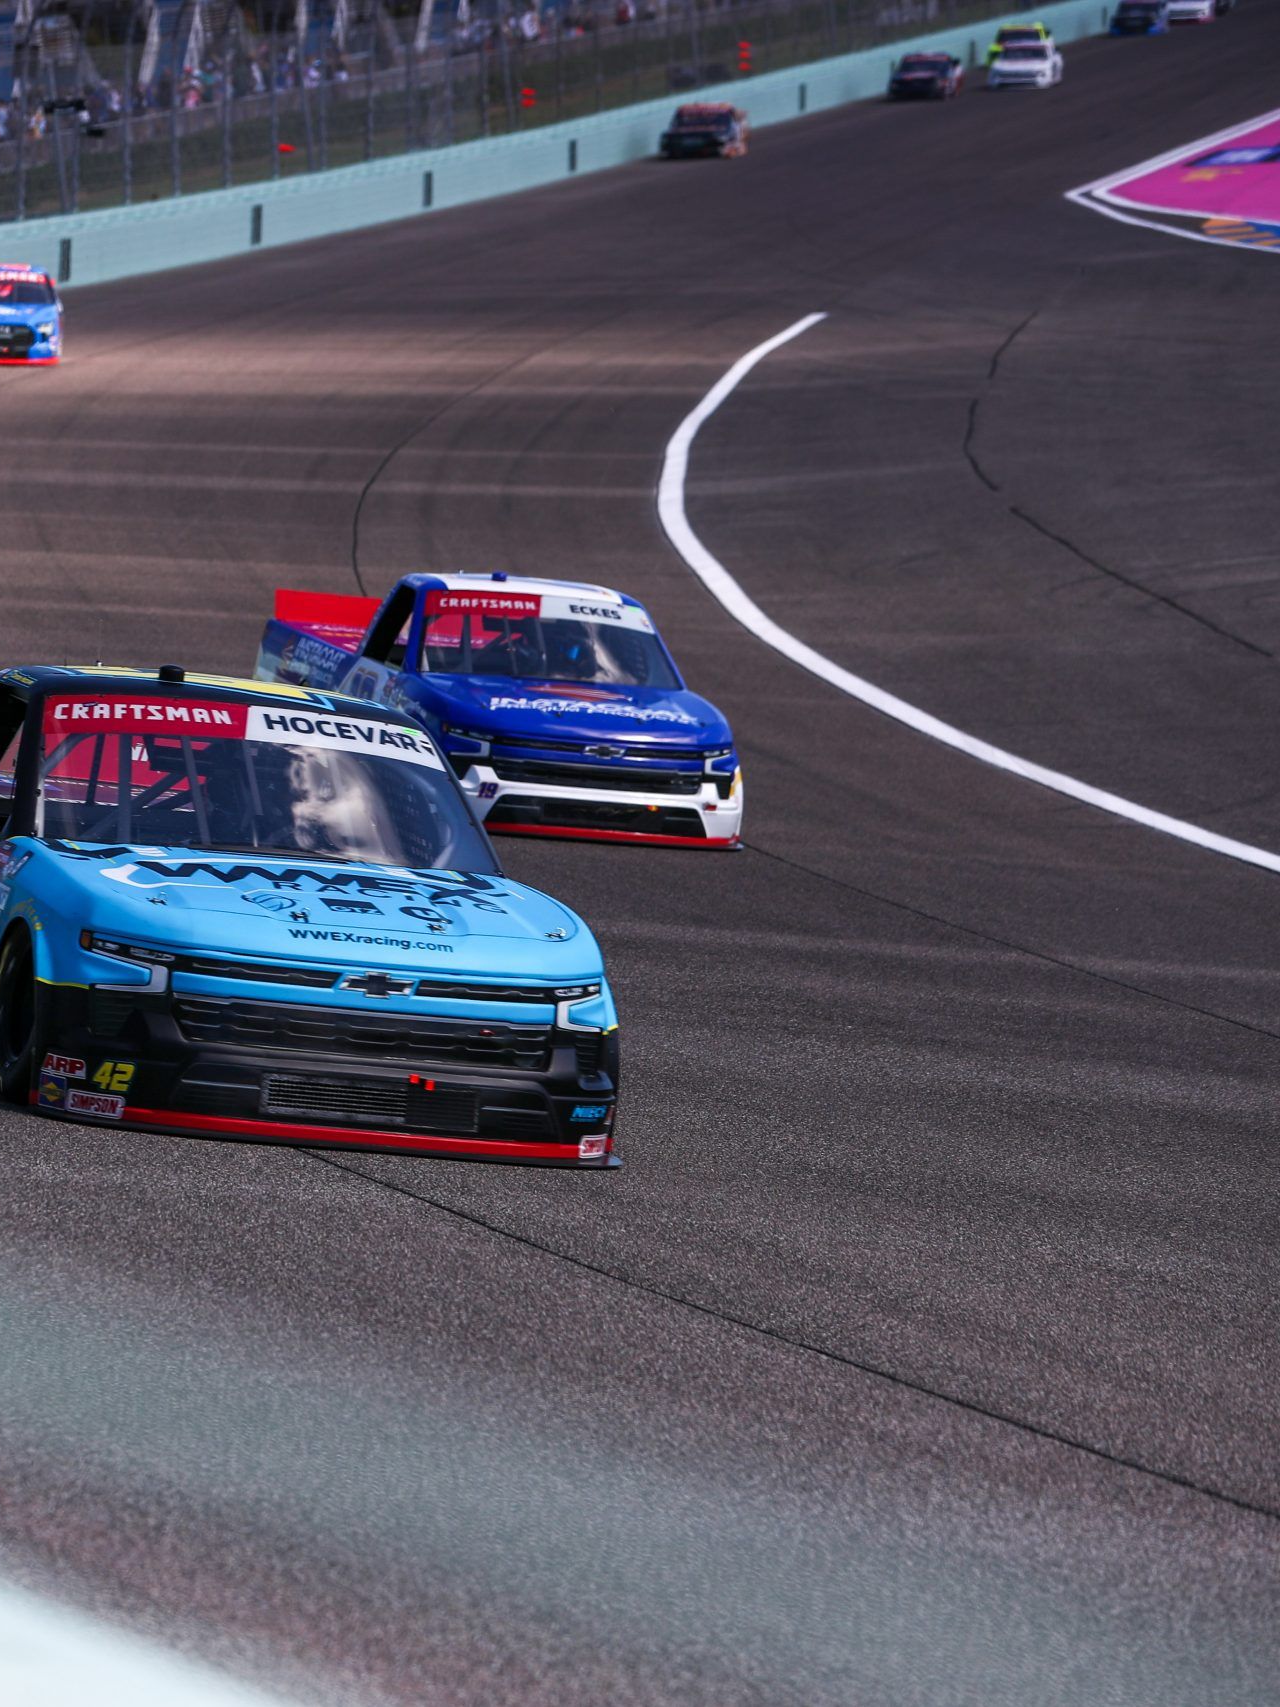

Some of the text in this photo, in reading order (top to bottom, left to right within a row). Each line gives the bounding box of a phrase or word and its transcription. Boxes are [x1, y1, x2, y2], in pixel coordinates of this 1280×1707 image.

[439, 597, 537, 611] CRAFTSMAN
[569, 603, 622, 621] ECKES
[53, 702, 234, 726] CRAFTSMAN
[262, 713, 422, 754] HOCEVAR
[477, 781, 500, 799] 19
[288, 929, 454, 953] WWEXracing.com
[42, 1054, 85, 1076] ARP
[93, 1060, 136, 1092] 42
[70, 1092, 120, 1115] SIMPSON
